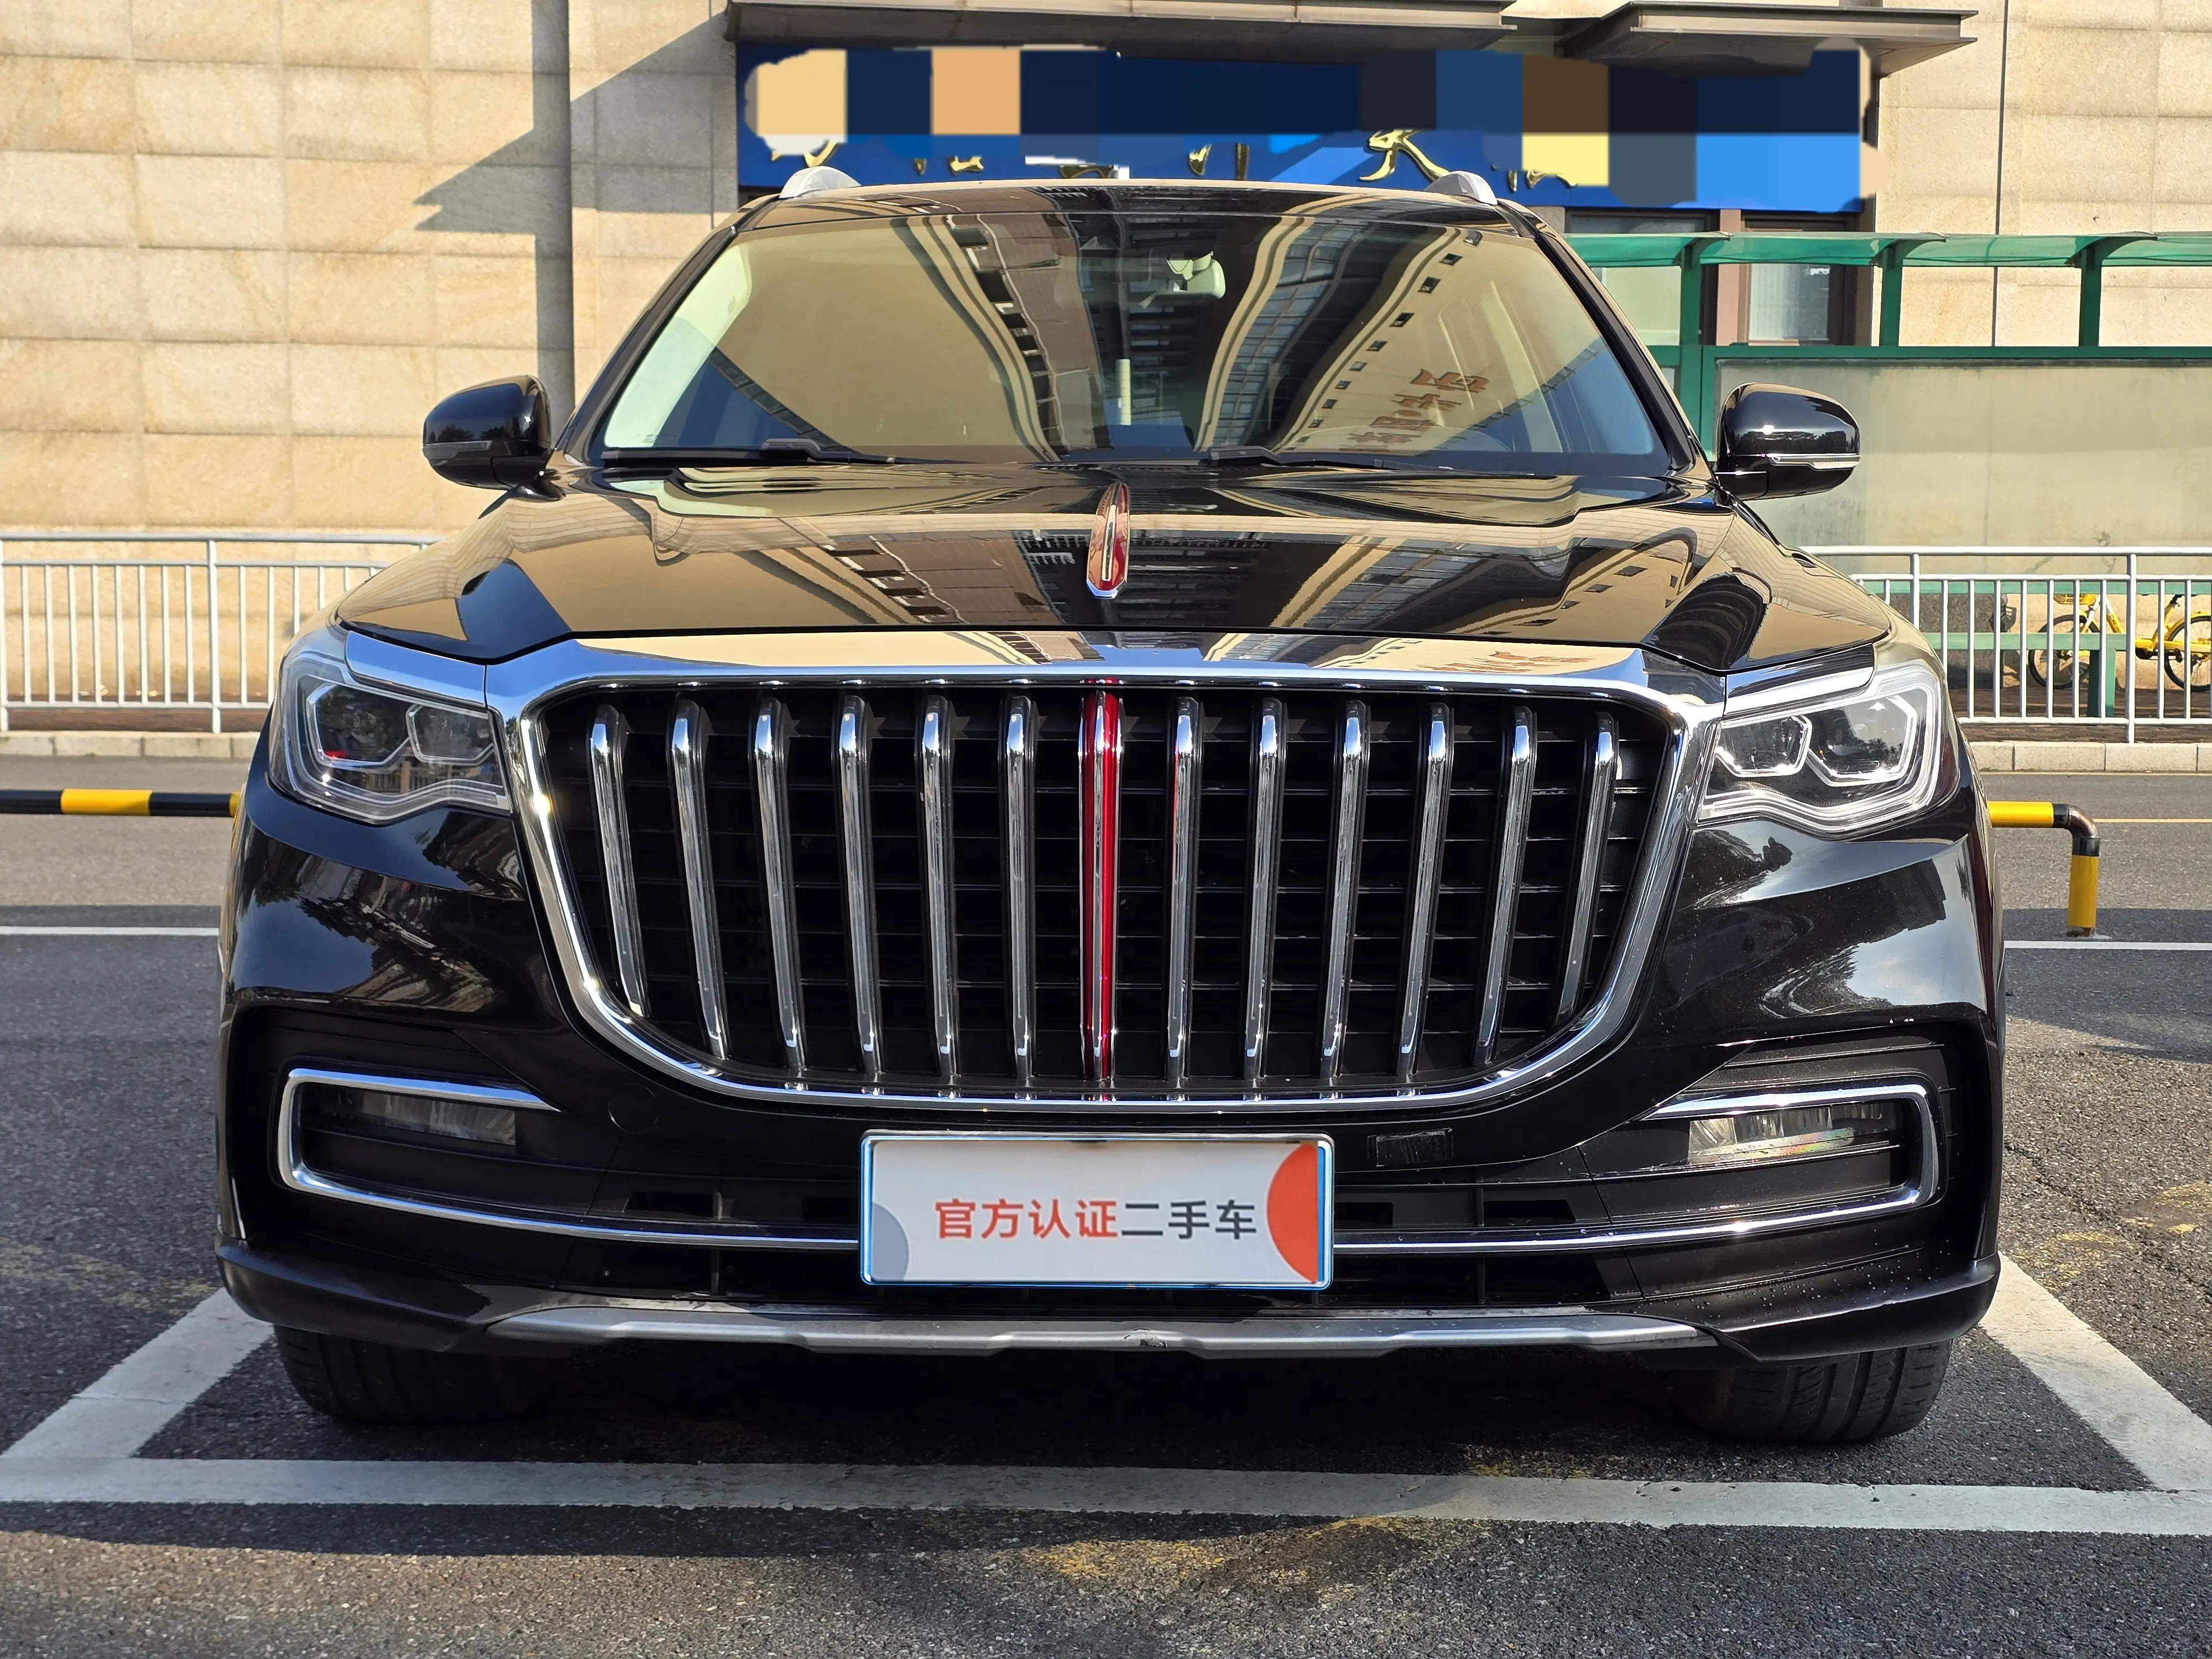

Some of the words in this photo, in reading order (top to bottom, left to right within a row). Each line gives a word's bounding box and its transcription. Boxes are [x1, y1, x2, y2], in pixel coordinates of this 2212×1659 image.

[935, 1198, 1257, 1240] 官方认证二手车
